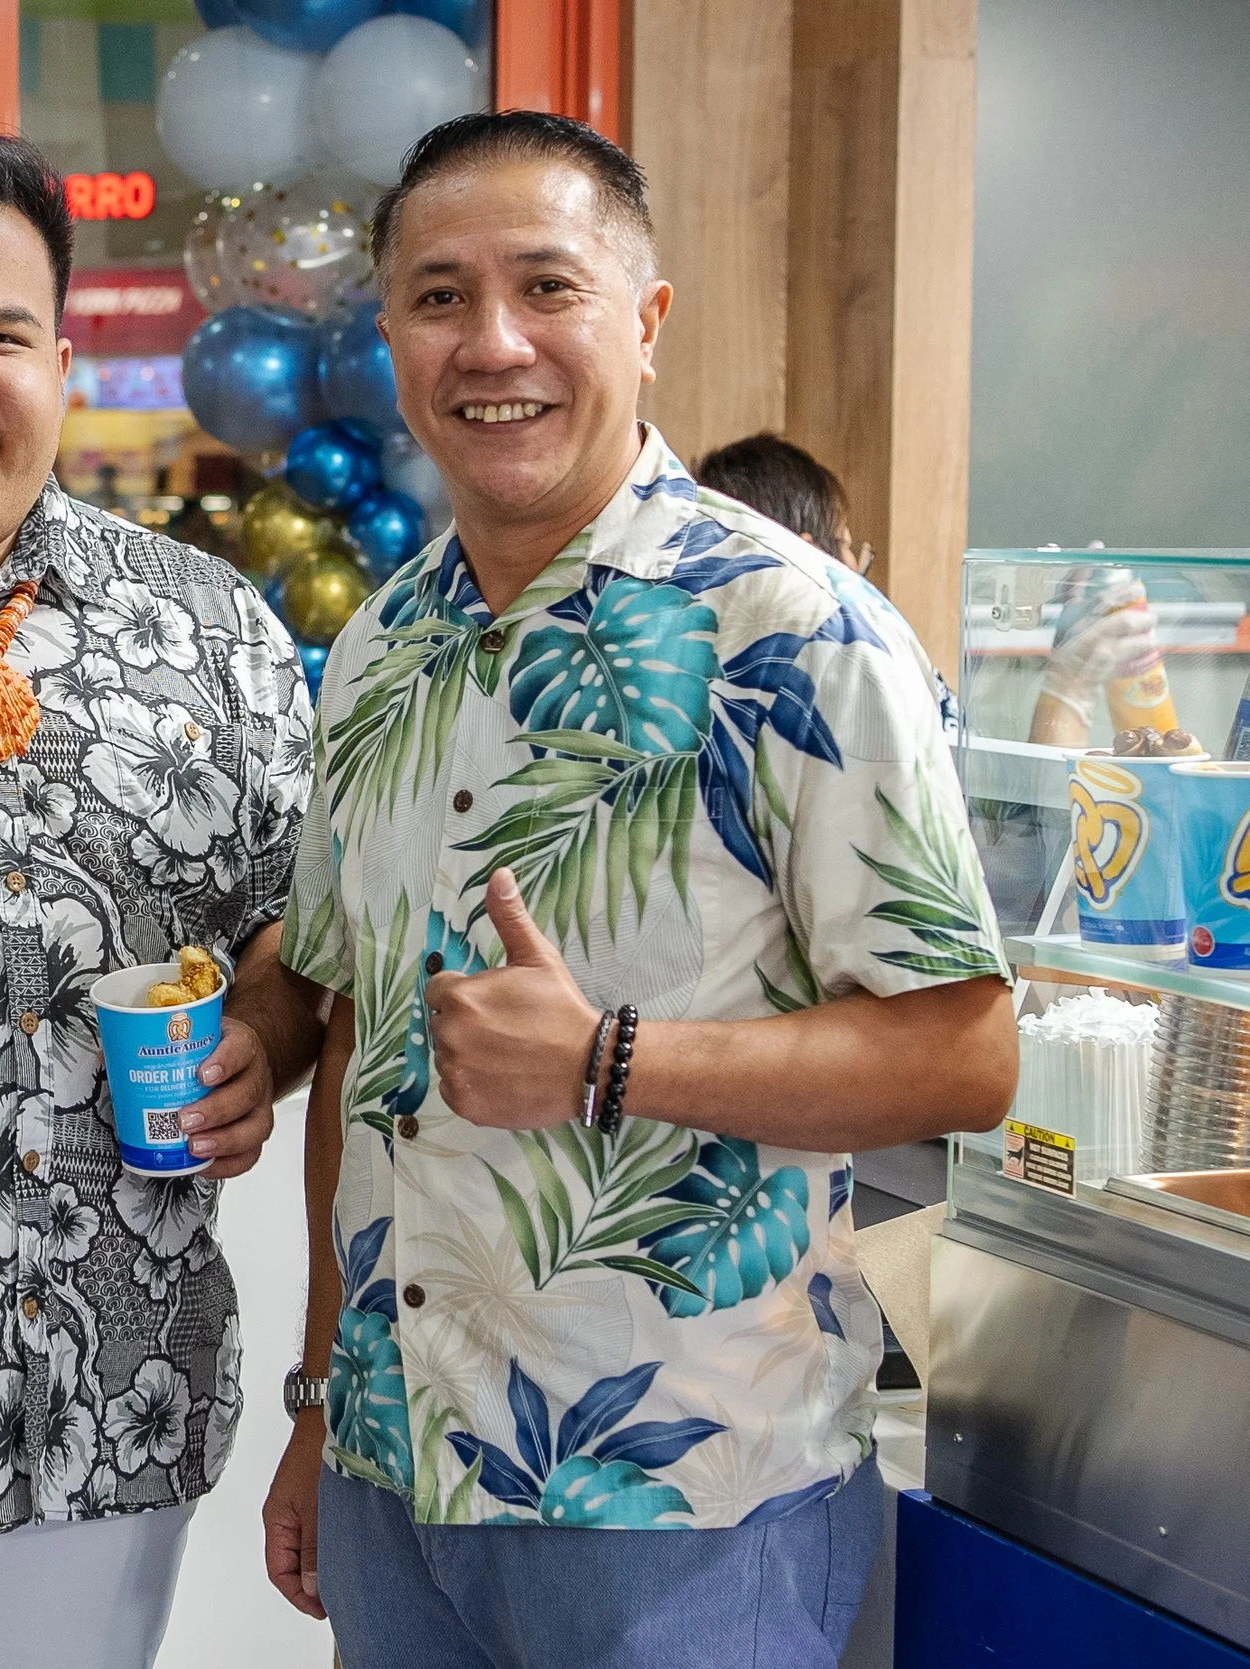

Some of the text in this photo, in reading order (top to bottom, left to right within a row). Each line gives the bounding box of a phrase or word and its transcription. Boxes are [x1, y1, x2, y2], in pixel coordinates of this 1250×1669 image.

[138, 1045, 182, 1056] Auntie
[129, 1069, 168, 1084] ORDER
[172, 1067, 184, 1082] IN
[187, 1063, 200, 1079] TH
[160, 1082, 186, 1092] DELIVERY
[1023, 1126, 1056, 1143] CAUTION
